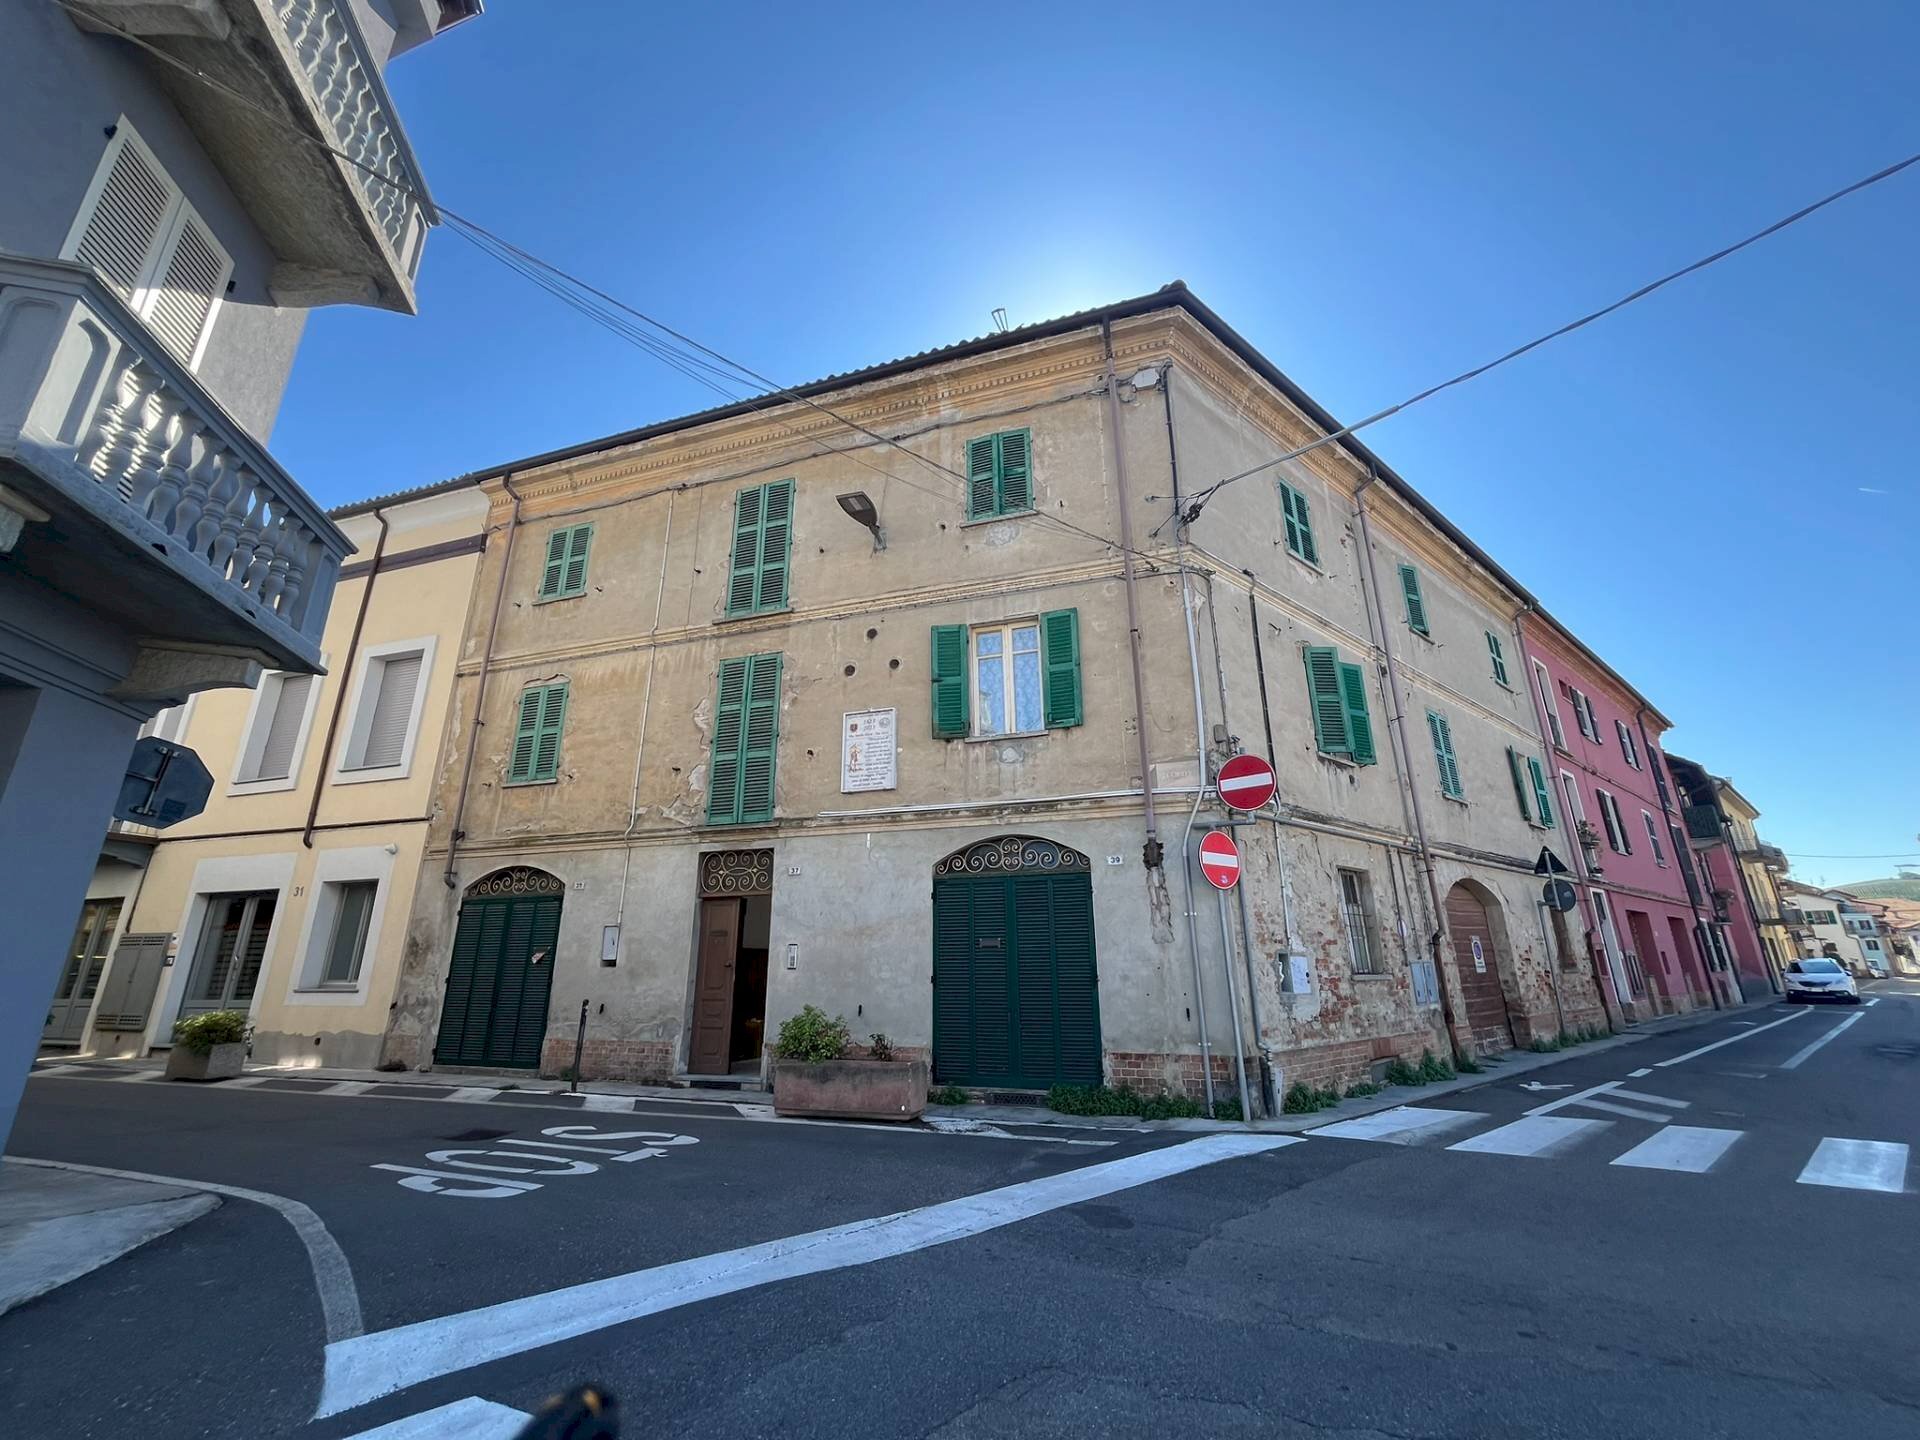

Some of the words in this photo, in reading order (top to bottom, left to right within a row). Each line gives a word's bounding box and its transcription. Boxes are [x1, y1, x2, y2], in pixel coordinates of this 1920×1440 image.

[1110, 856, 1121, 864] 39
[293, 886, 305, 897] 31
[369, 1126, 700, 1198] STOP
